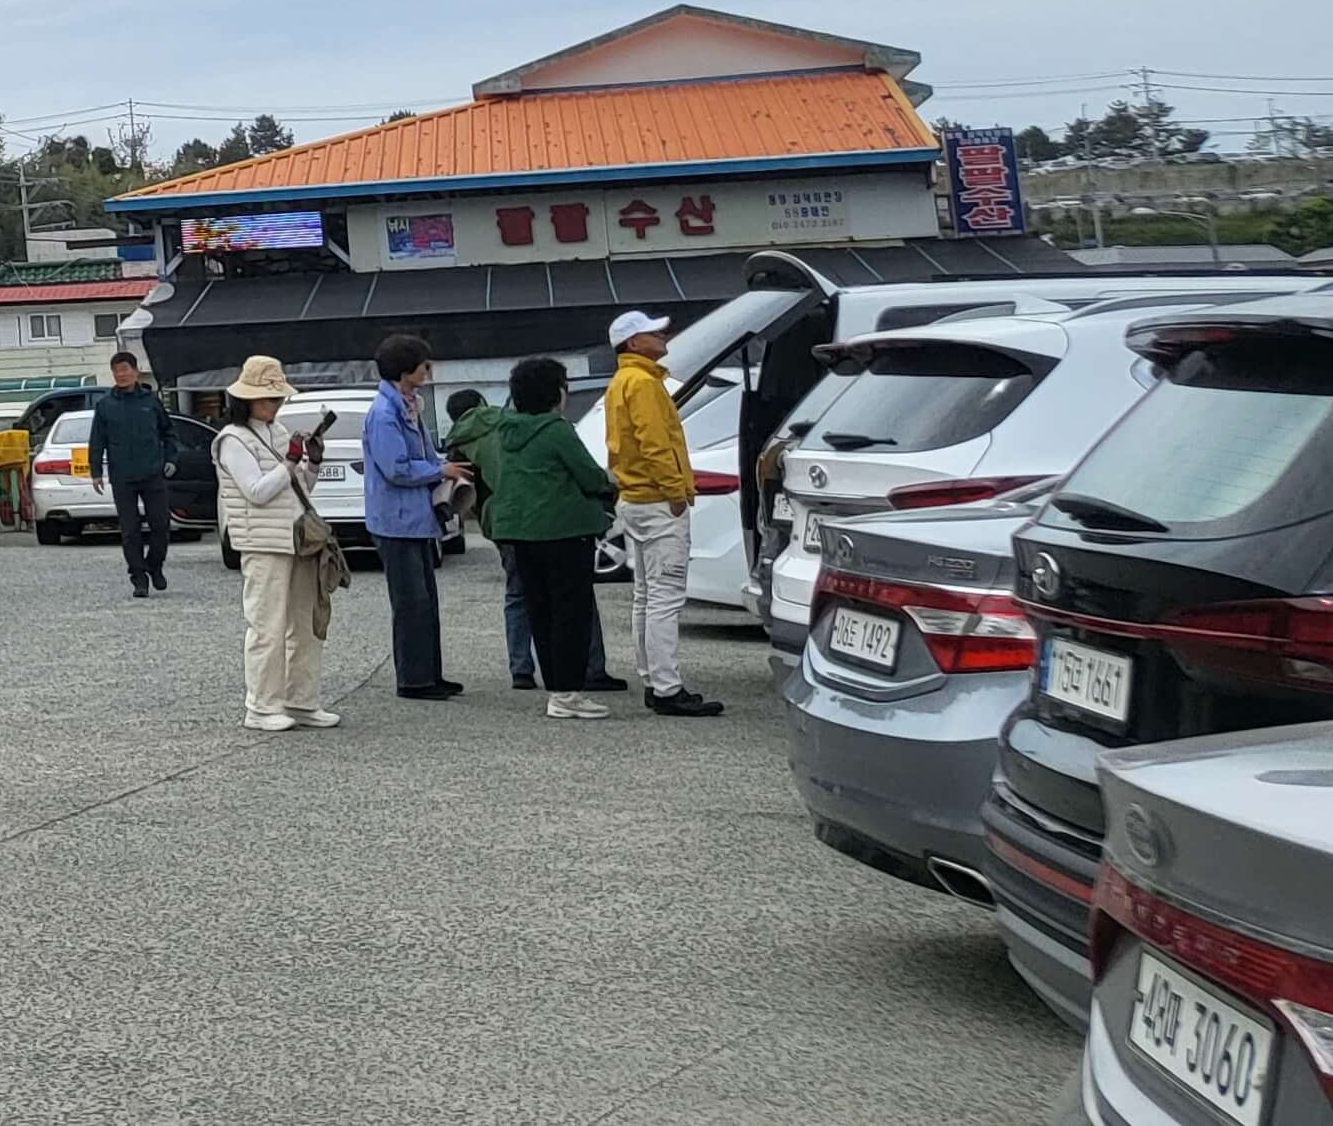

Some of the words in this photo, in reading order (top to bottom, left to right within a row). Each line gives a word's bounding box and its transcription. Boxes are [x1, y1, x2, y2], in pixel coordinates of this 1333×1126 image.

[496, 195, 716, 246] 수산
[861, 620, 891, 659] 1492
[1187, 1001, 1254, 1107] 3060
